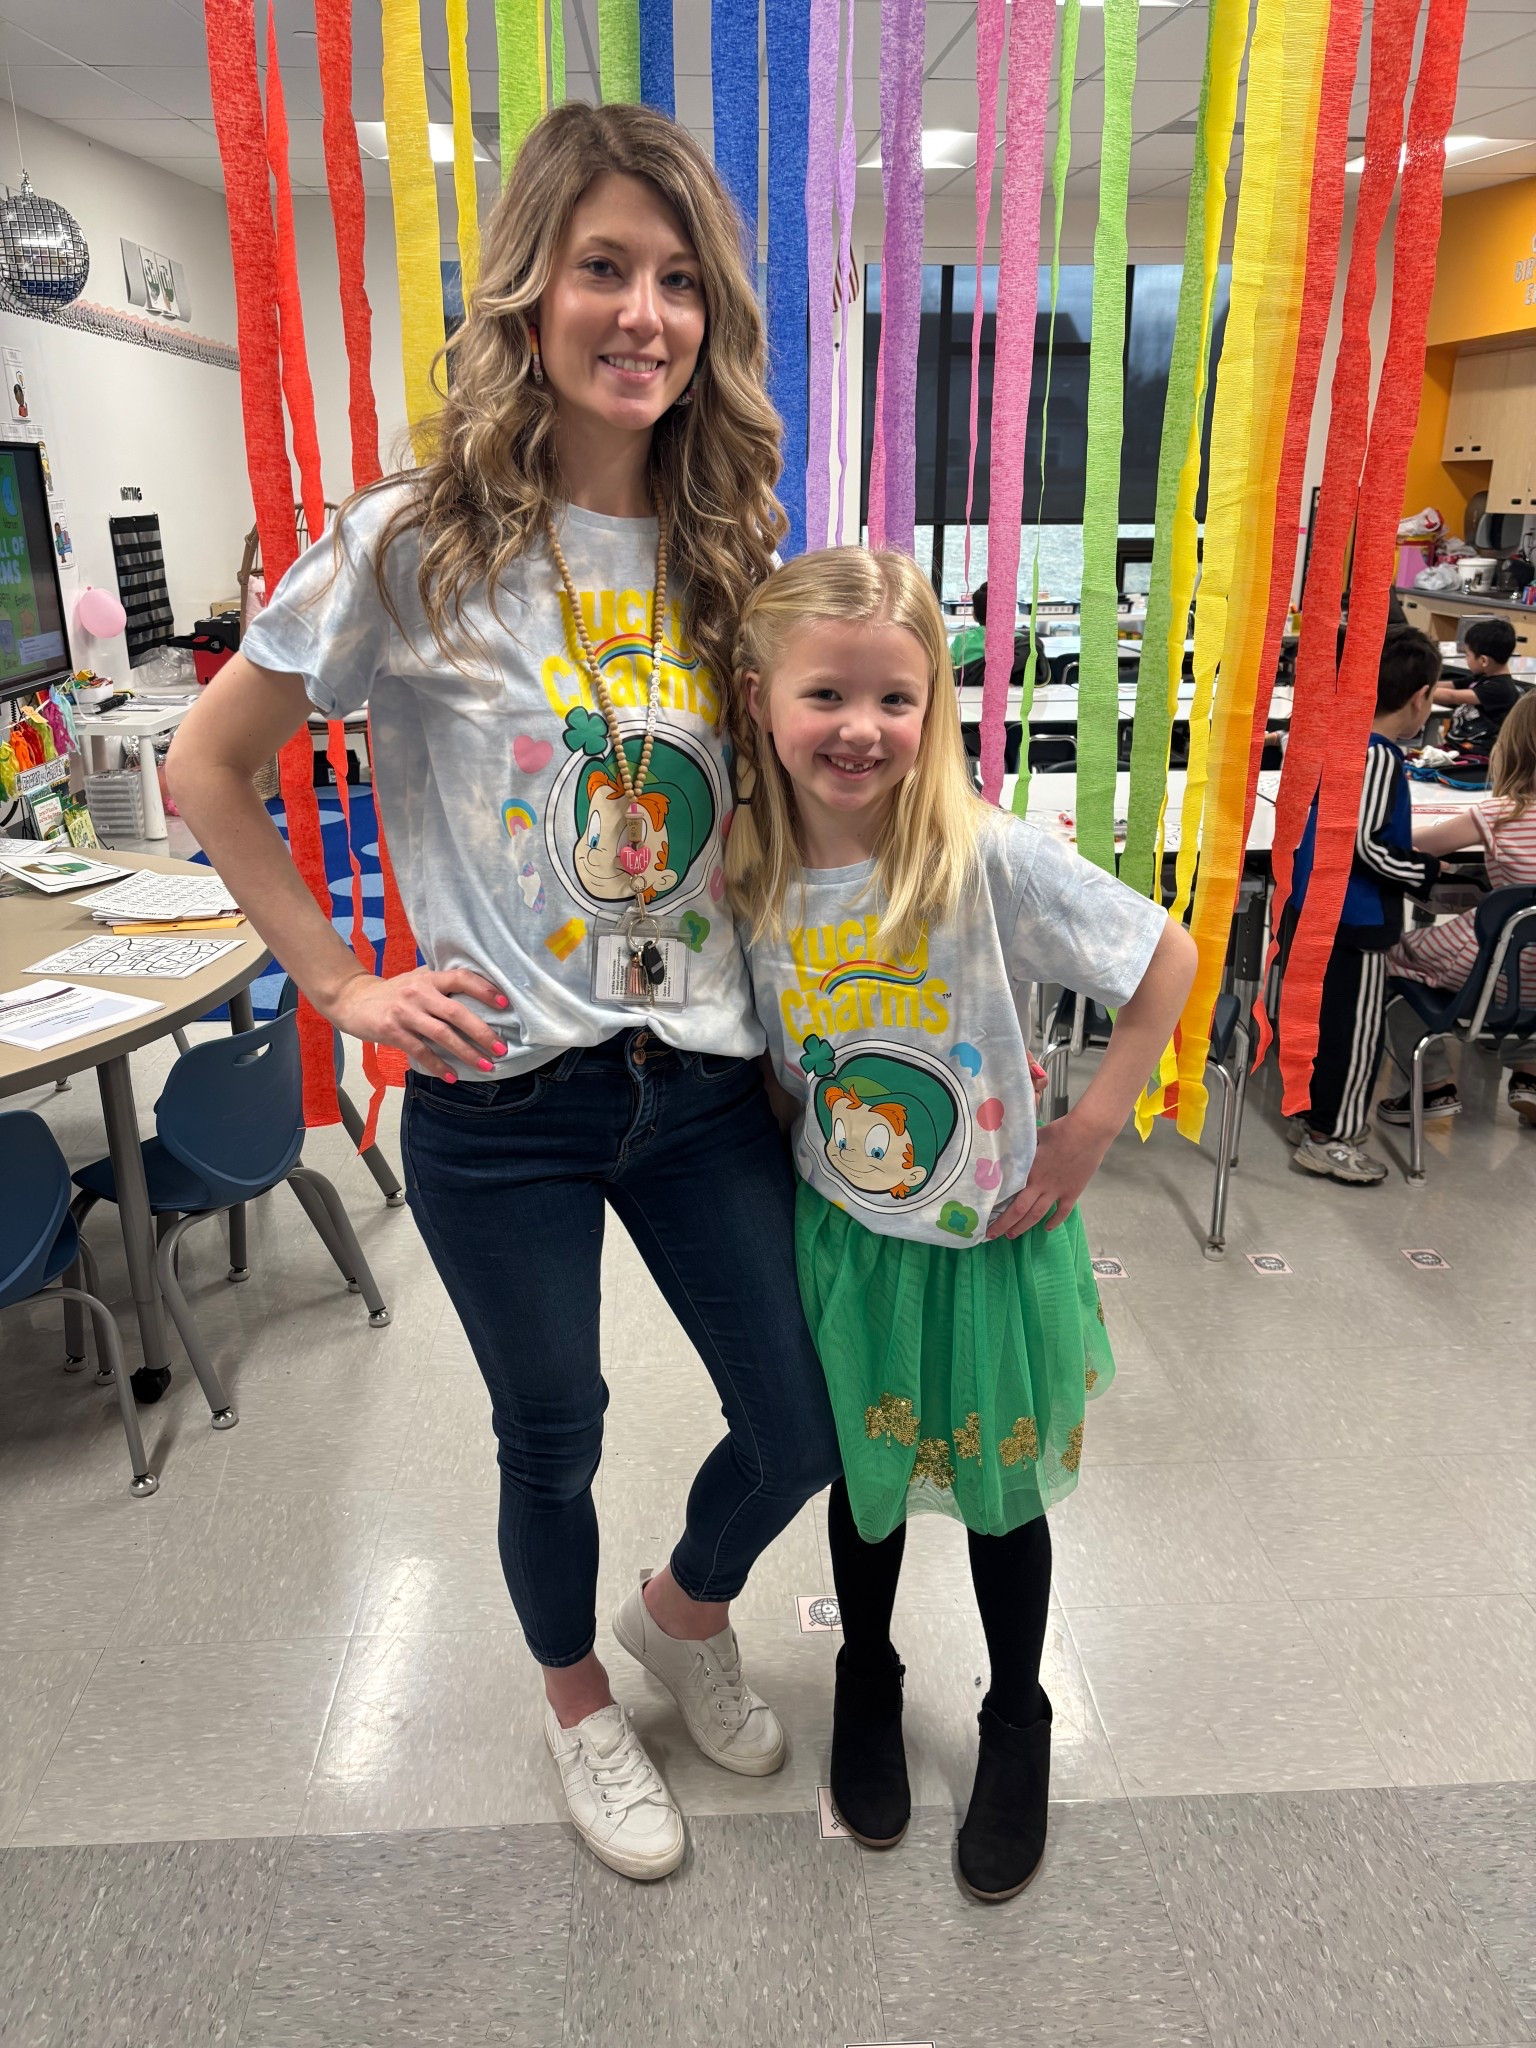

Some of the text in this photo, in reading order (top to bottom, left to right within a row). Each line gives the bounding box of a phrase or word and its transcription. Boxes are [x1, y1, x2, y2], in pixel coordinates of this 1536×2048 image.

[0, 560, 21, 585] MS
[624, 848, 649, 870] TEACH
[780, 978, 949, 1046] Charms
[822, 1604, 838, 1618] 9
